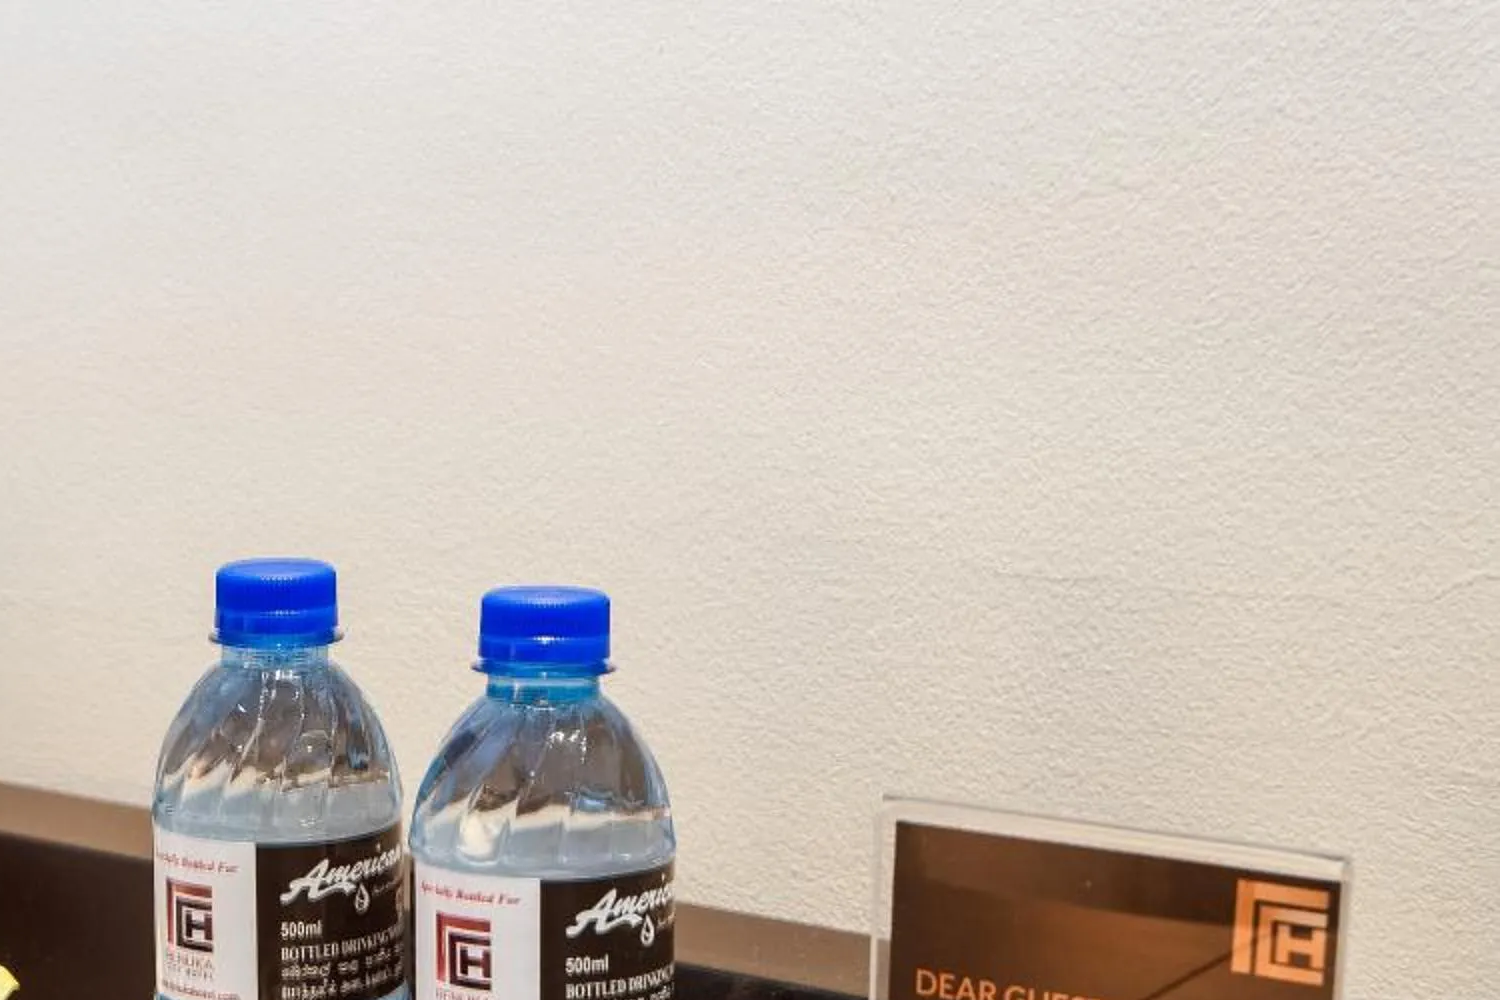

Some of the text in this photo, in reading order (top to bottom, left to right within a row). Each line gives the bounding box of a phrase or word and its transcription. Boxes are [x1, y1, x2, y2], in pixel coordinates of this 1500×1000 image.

[281, 919, 322, 940] 500ml
[280, 942, 340, 962] BOTTLED
[565, 953, 609, 976] 500ml
[565, 979, 627, 1000] BOTTLED
